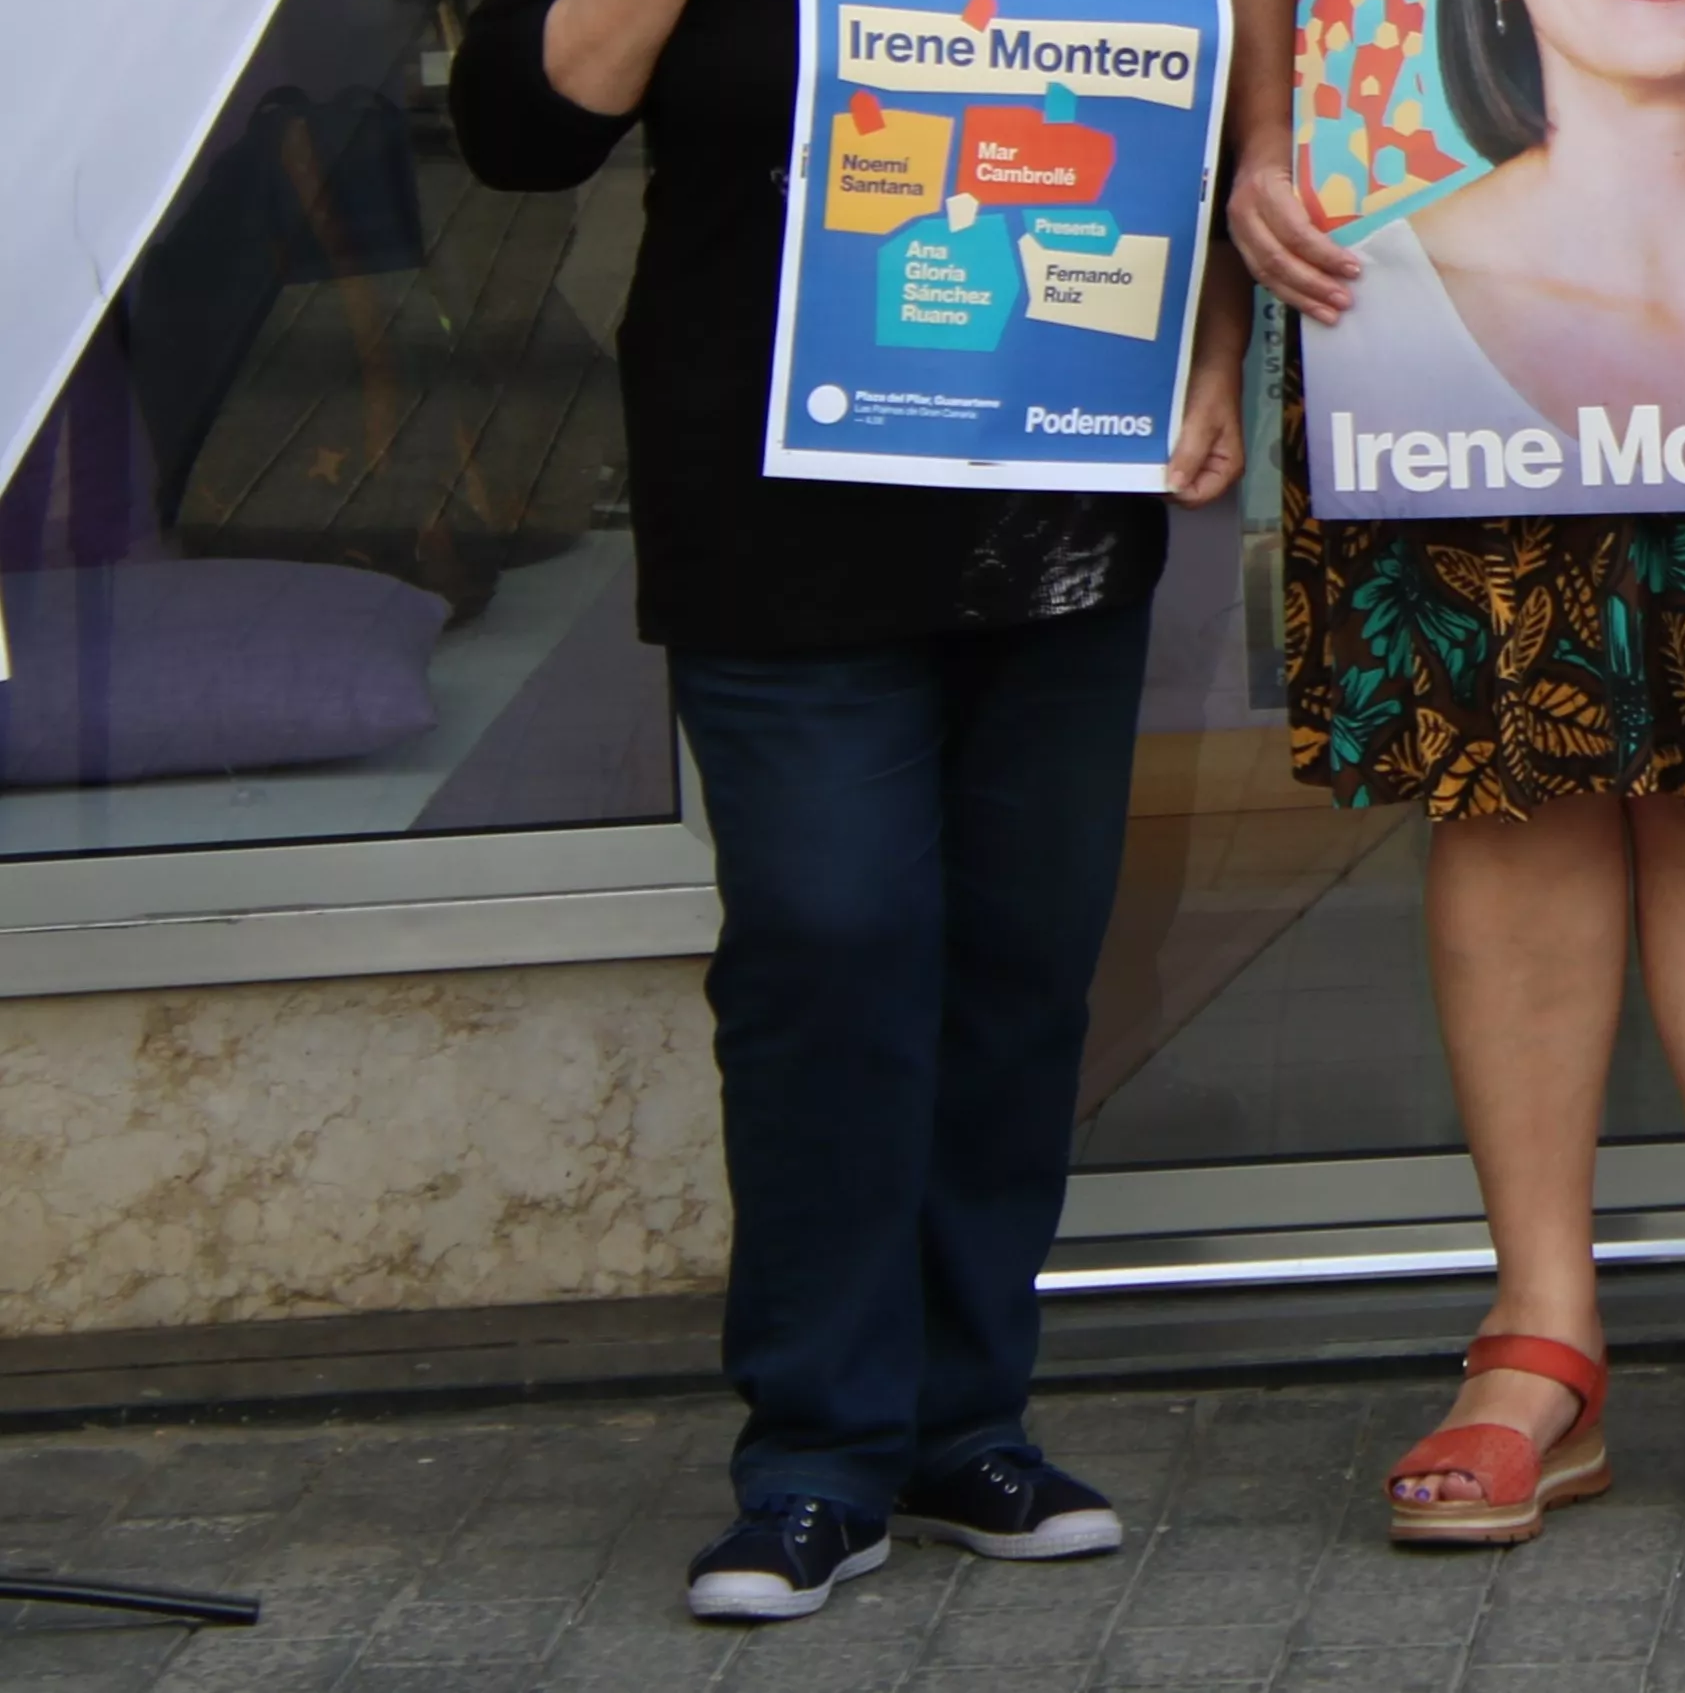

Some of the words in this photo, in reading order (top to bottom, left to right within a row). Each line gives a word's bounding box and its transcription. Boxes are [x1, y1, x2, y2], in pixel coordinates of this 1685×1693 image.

[849, 19, 975, 67] Irene
[989, 29, 1190, 81] Montero
[977, 141, 1018, 161] Mar
[842, 154, 909, 174] Noemí
[976, 163, 1077, 186] Cambrollé
[840, 175, 924, 196] Santana
[1034, 218, 1107, 237] Presenta
[905, 240, 948, 259] Ana
[905, 262, 967, 282] Gloria
[1046, 264, 1133, 285] Fernando
[903, 283, 992, 305] Sánchez
[1043, 286, 1083, 304] Ruiz
[901, 304, 969, 325] Ruano
[1024, 406, 1152, 436] Podemos
[1331, 411, 1563, 493] Irene
